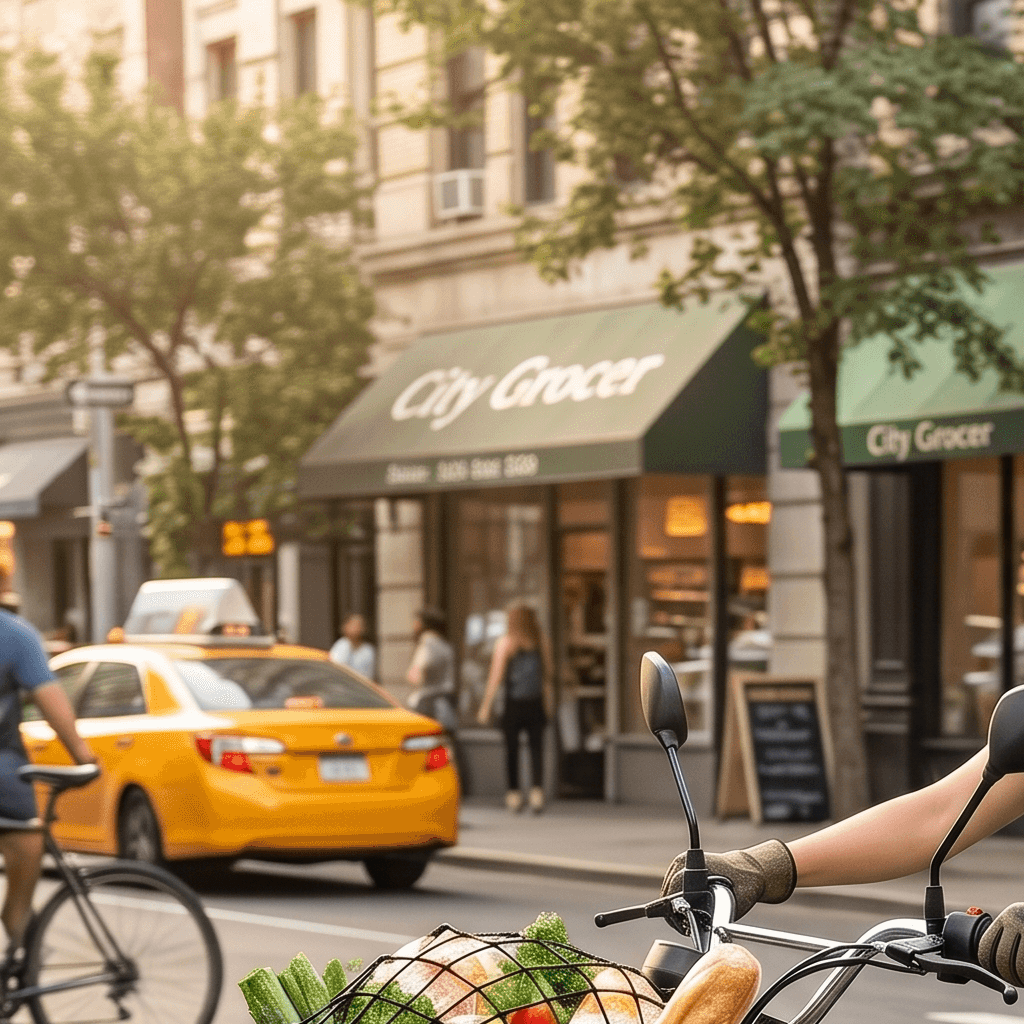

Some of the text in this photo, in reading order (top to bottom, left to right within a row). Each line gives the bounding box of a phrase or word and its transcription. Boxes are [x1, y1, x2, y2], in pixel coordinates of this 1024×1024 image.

[391, 354, 666, 432] City Grocer
[866, 420, 996, 462] City Grocer
